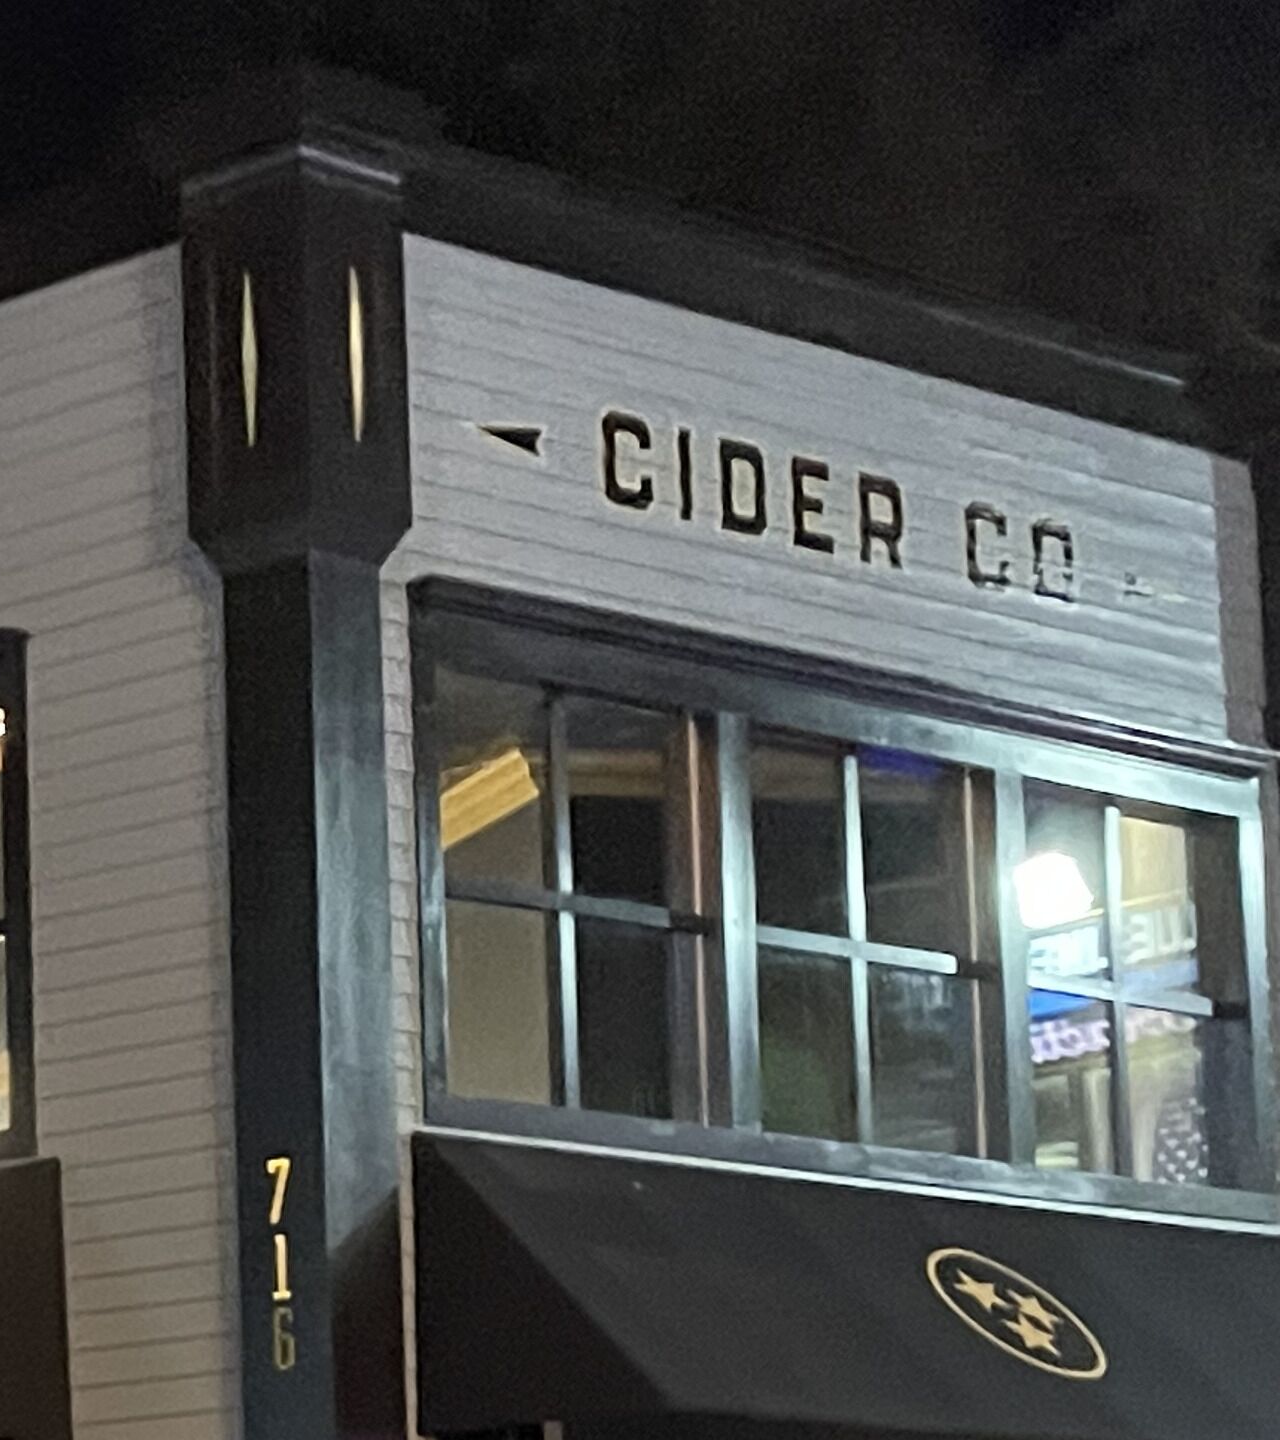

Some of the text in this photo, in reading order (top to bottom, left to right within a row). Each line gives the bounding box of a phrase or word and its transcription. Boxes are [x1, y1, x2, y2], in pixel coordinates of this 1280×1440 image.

[600, 410, 1075, 604] CIDER CO
[265, 1156, 296, 1371] 716
